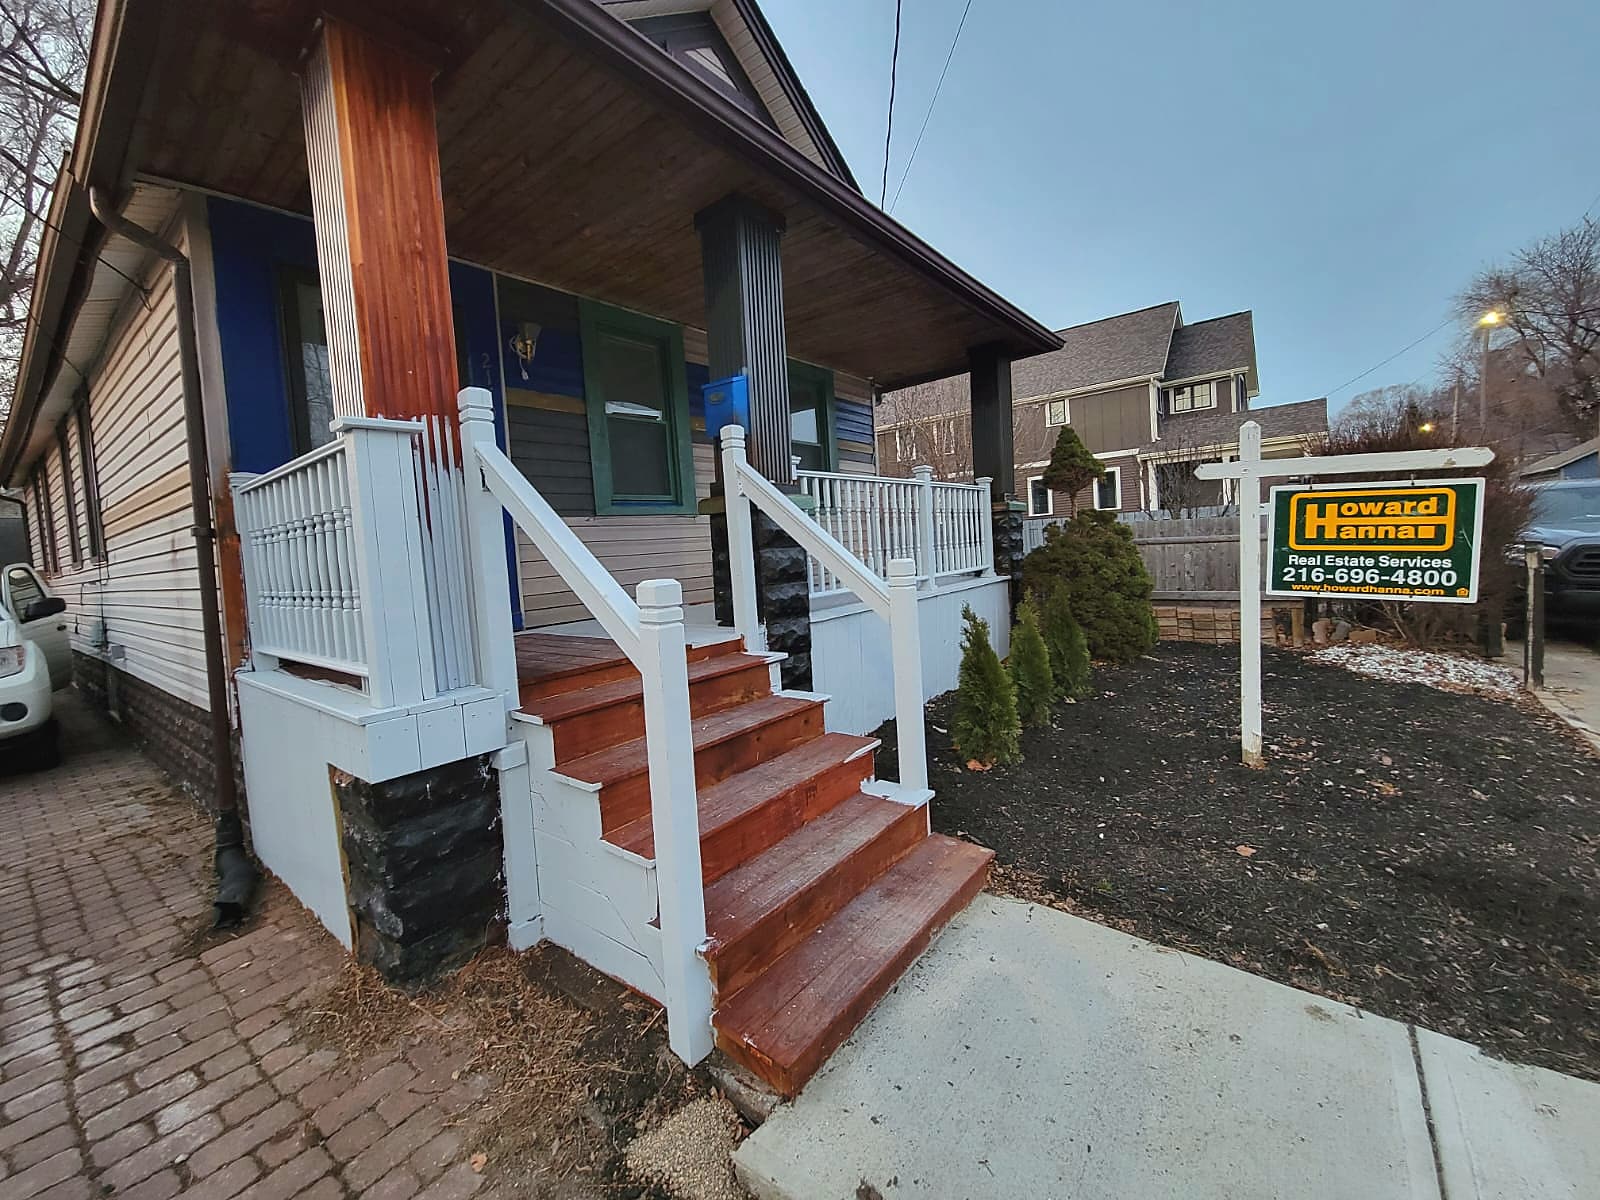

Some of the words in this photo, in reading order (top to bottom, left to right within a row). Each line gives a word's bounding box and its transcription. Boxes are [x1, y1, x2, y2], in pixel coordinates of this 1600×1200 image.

[1288, 554, 1321, 566] Real
[1324, 555, 1375, 567] Estate
[1378, 555, 1452, 568] Services
[1282, 567, 1457, 586] 216-696-4800
[1291, 583, 1445, 596] www.howardhanna.com
